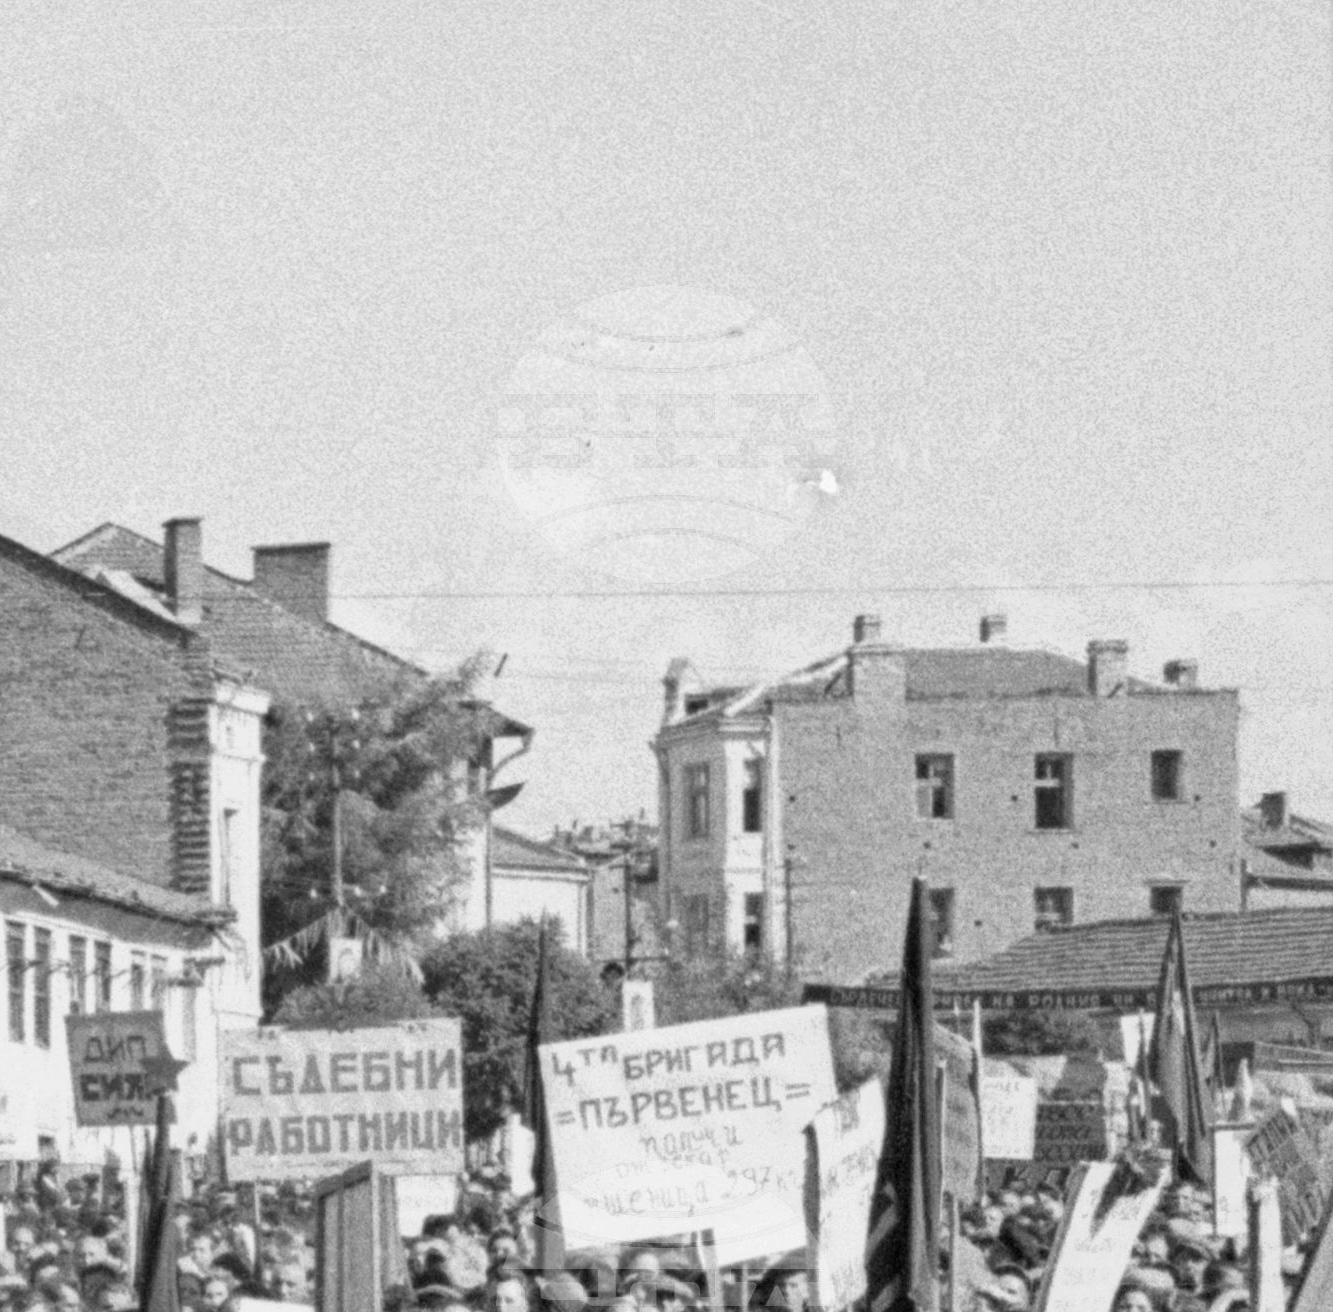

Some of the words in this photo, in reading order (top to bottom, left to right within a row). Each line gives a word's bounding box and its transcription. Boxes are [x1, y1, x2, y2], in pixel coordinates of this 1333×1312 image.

[232, 1047, 458, 1097] СЪДЕБНИ
[623, 1032, 786, 1080] БРИГАДА
[228, 1108, 462, 1157] РАБОТНИЦИ
